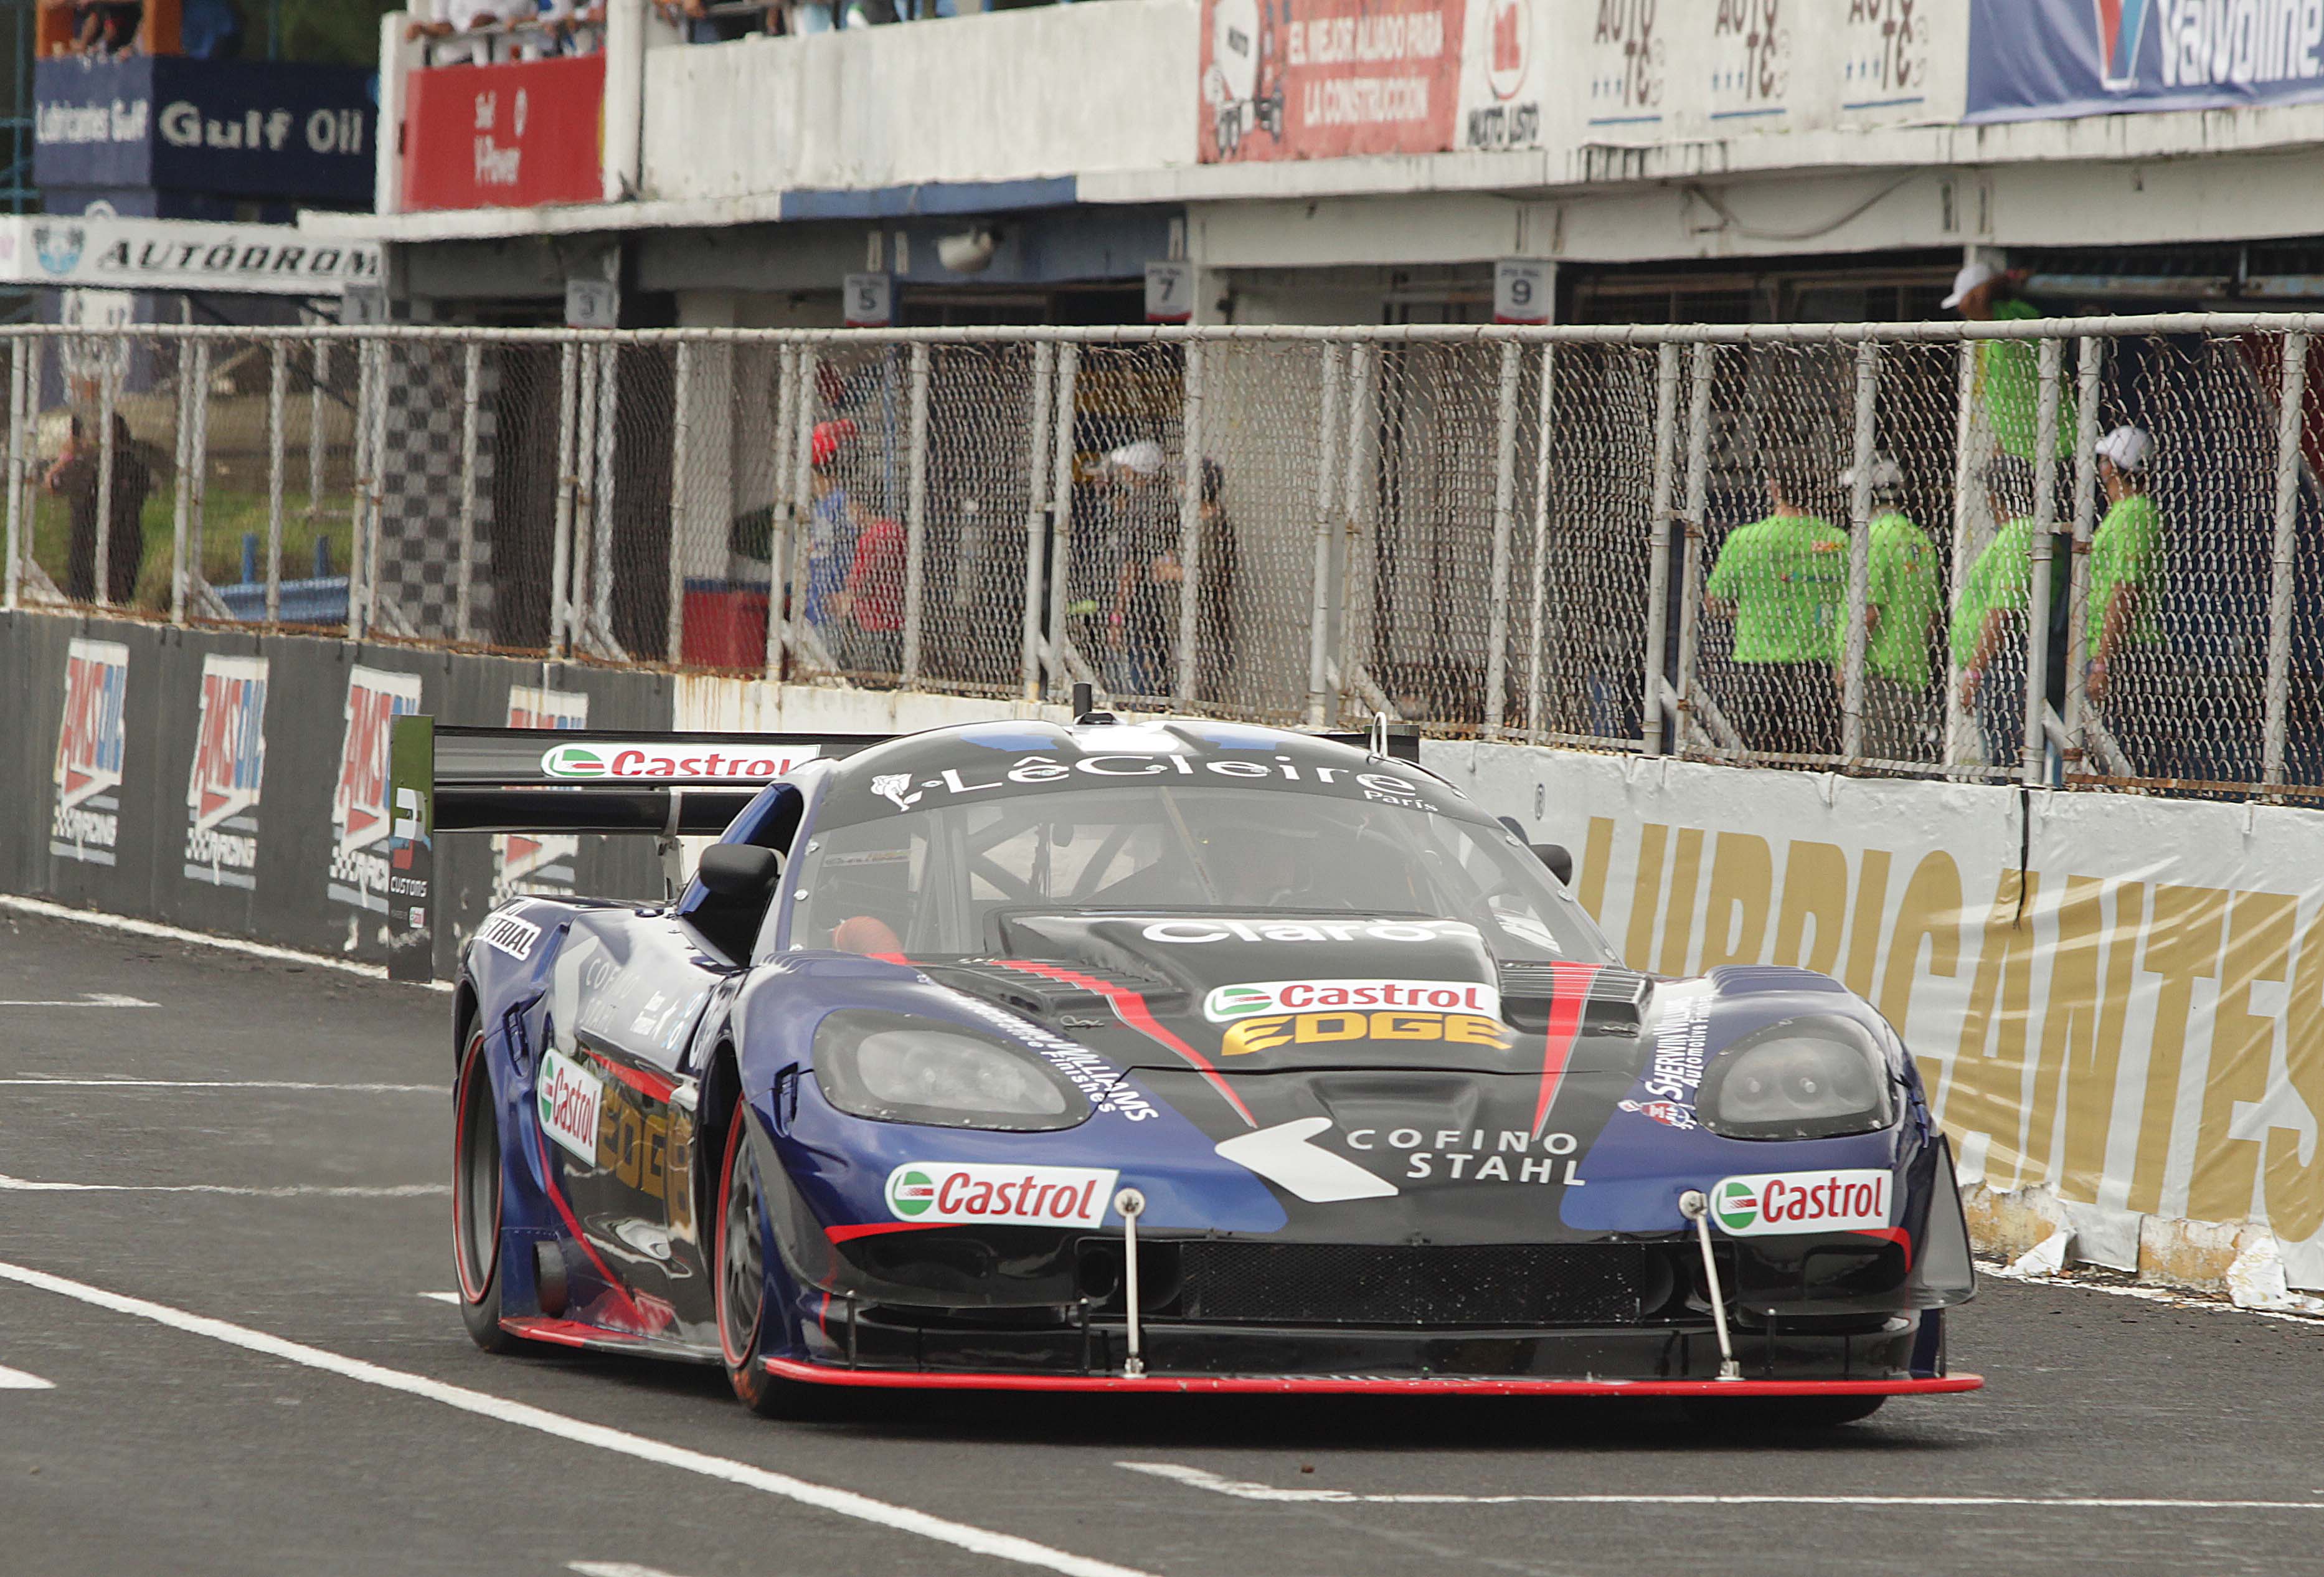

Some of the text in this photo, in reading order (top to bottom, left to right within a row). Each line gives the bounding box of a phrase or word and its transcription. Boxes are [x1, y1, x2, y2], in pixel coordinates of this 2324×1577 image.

[159, 100, 364, 155] Gulf Oil
[1511, 279, 1531, 305] 9
[390, 876, 428, 897] CUSTOMS
[1142, 920, 1436, 943] Claro
[1279, 984, 1485, 1011] Castrol
[1221, 1011, 1514, 1056] EDGE
[1681, 1025, 1708, 1089] Automotive
[1041, 1049, 1116, 1113] Finishes
[552, 1067, 597, 1147] Castrol
[1346, 1129, 1578, 1156] COFINO
[1407, 1152, 1585, 1186] STAHL
[938, 1172, 1097, 1220] Castrol
[1762, 1176, 1884, 1223] Castrol
